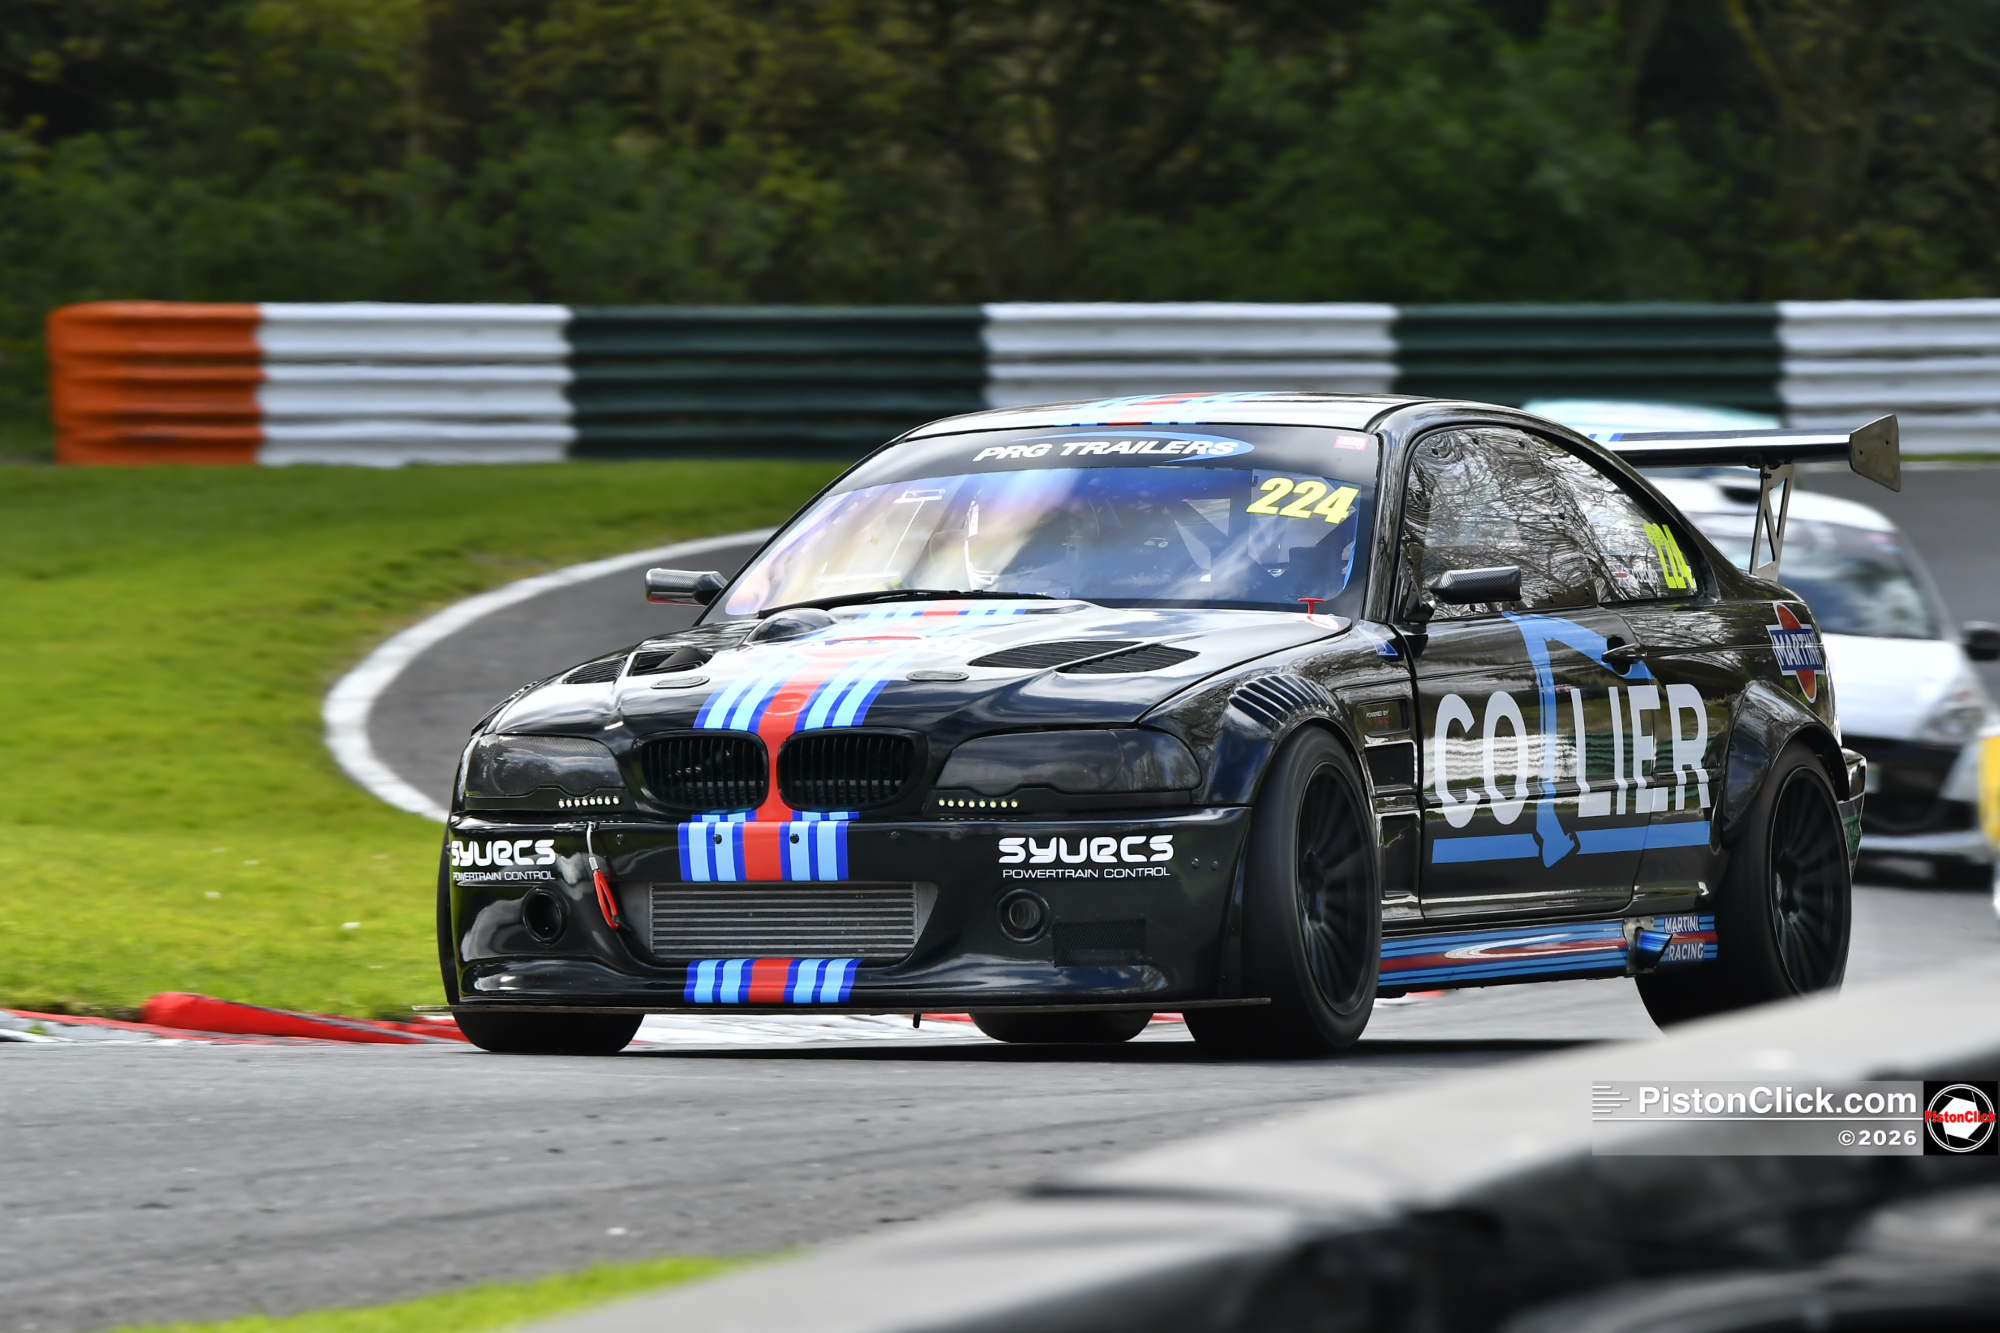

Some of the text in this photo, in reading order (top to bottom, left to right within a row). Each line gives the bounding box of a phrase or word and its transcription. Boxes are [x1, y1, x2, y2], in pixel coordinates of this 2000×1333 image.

[972, 440, 1239, 462] PRG TRAILERS
[1246, 477, 1360, 525] 224
[1643, 523, 1697, 589] 224
[453, 870, 556, 881] POWERTRAIN CONTROL
[1003, 867, 1171, 879] POWERTRAIN CONTROL
[1665, 915, 1700, 933] MARTINI
[1668, 943, 1704, 961] RACING
